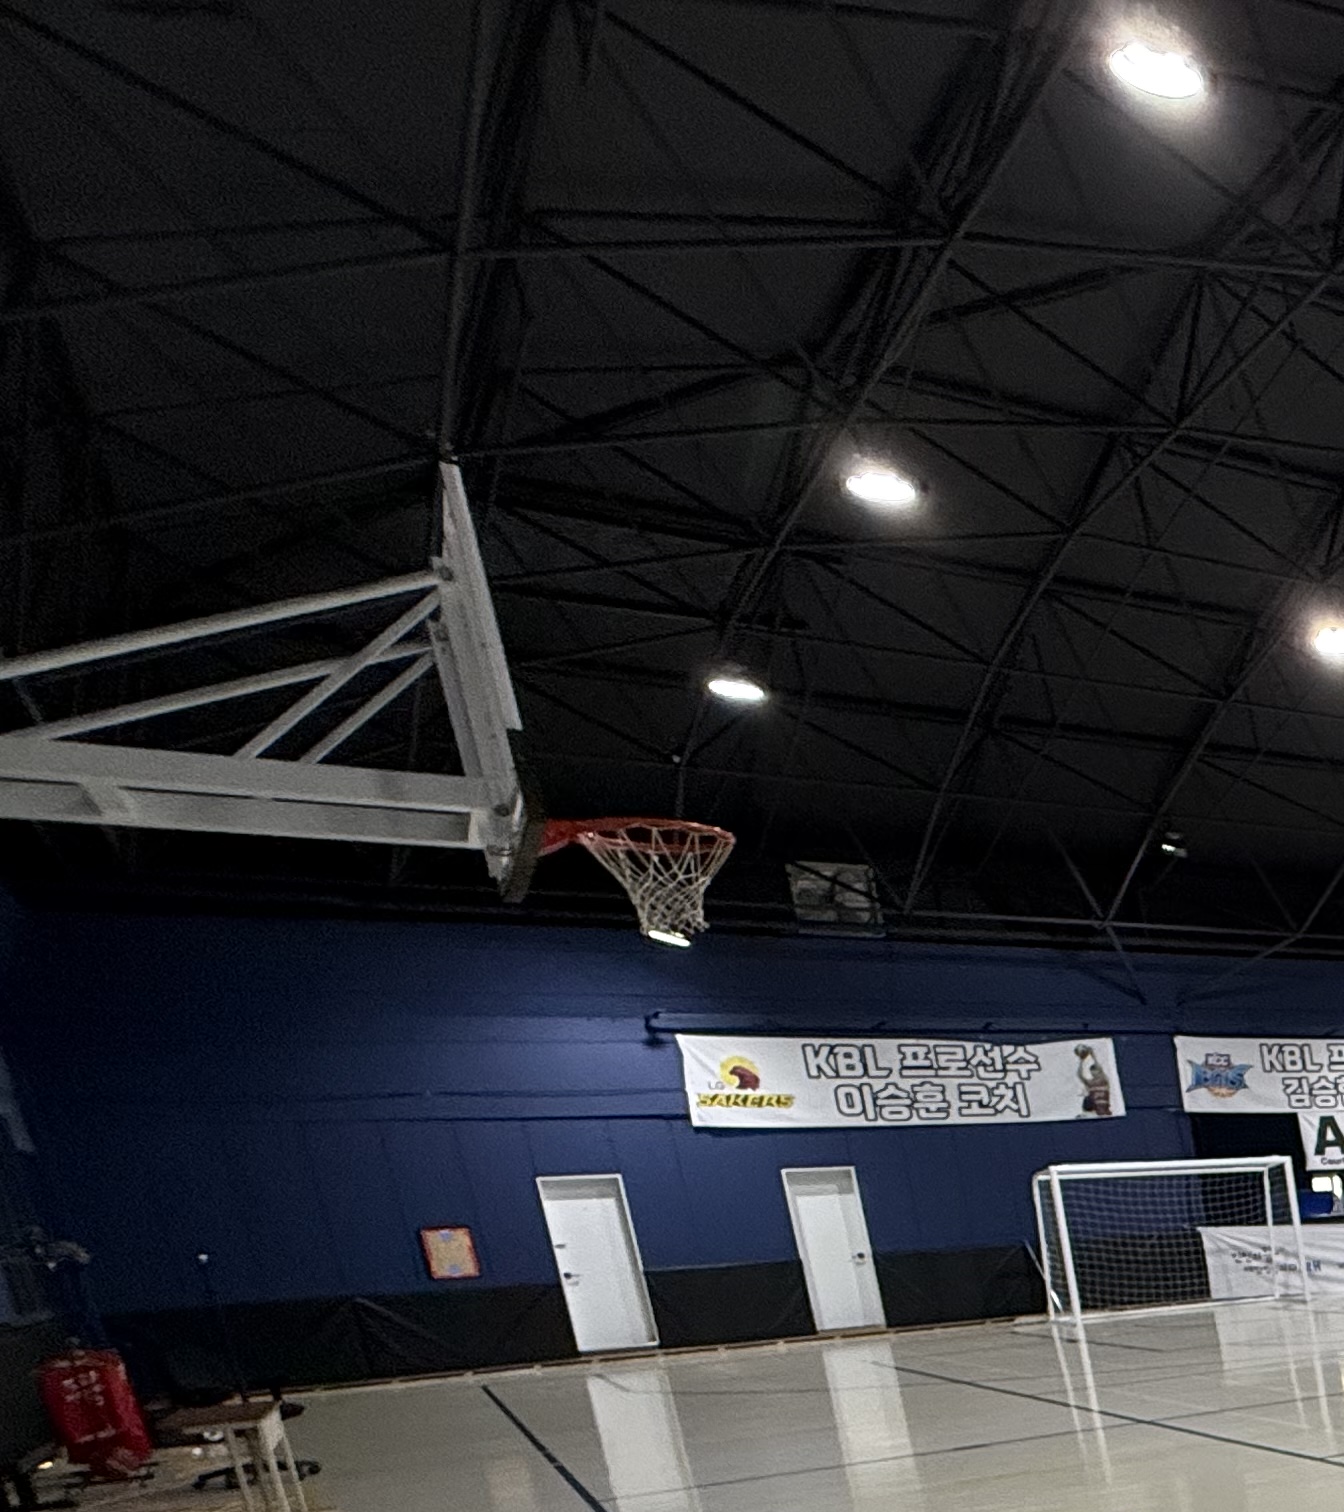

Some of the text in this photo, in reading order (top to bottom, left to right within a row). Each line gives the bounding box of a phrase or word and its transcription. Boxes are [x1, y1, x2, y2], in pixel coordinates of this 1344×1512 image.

[801, 1044, 1042, 1080] KBL 프로선수
[1259, 1043, 1323, 1073] KBL
[696, 1092, 796, 1109] SAKERS
[833, 1082, 1032, 1121] 이승훈 코치
